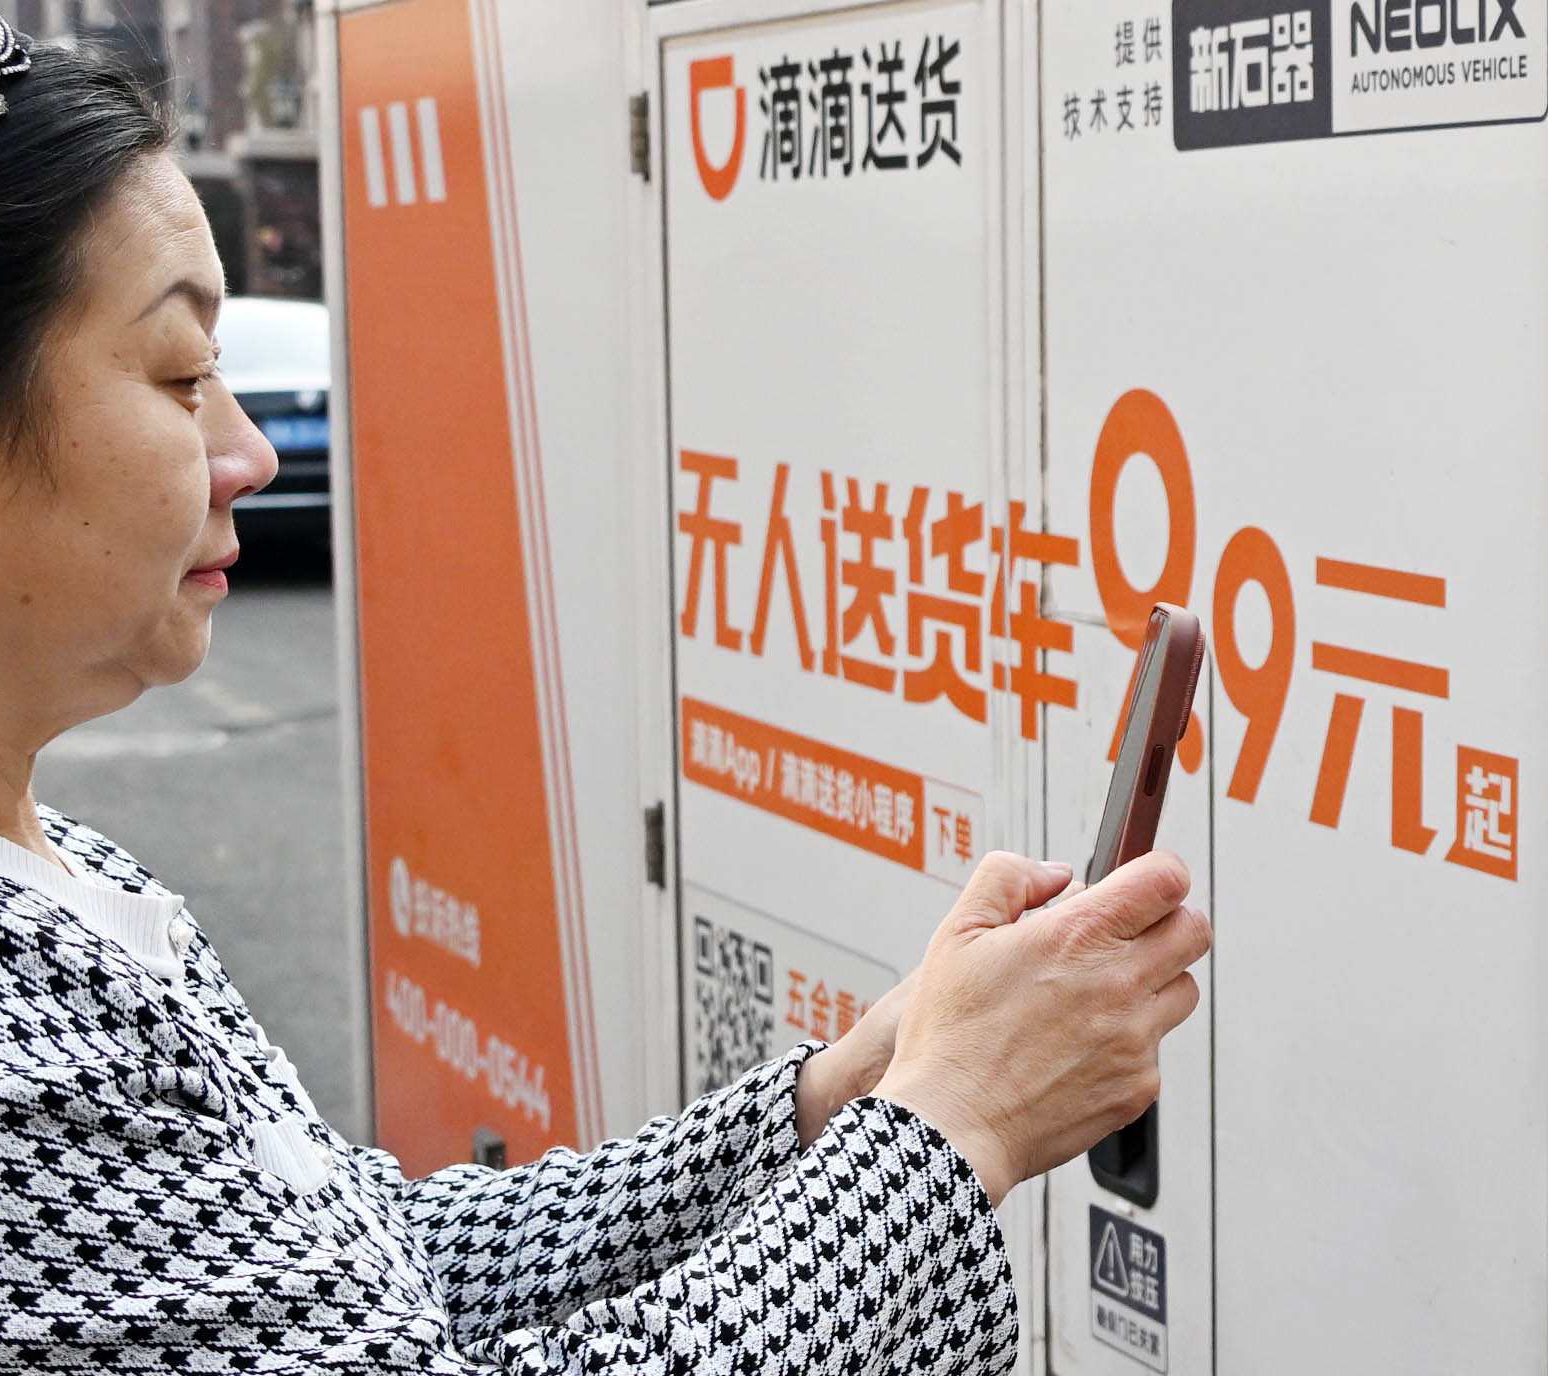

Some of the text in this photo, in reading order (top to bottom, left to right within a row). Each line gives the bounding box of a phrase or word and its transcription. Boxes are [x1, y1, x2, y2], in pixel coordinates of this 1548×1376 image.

[1115, 18, 1164, 68] 提供
[1189, 10, 1314, 113] 新石器
[1351, 55, 1528, 95] AUTONOMOUS VEHICLE
[758, 34, 962, 181] 滴滴送货
[1064, 81, 1164, 141] 技术支持
[933, 805, 973, 863] 下单
